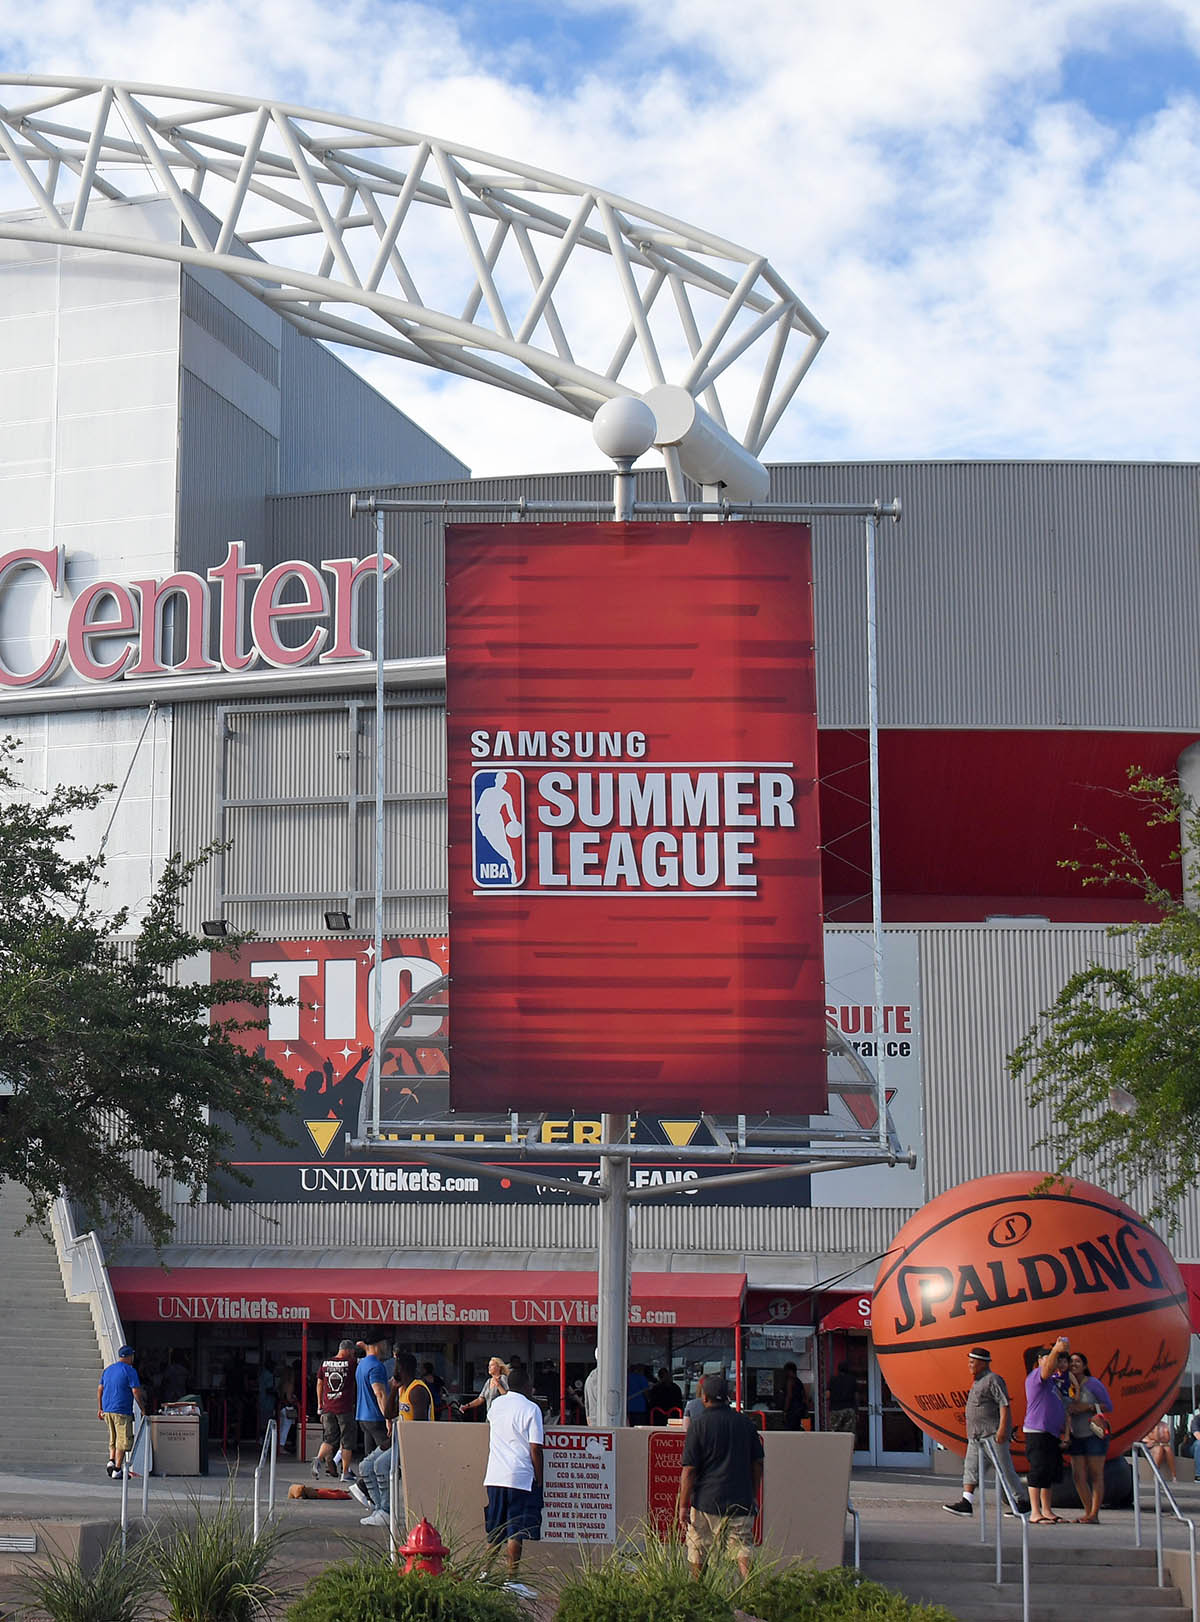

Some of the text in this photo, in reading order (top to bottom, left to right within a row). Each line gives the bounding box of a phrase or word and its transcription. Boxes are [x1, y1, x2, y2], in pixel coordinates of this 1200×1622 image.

[470, 730, 646, 758] SAMSUNG
[538, 771, 795, 827] SUMMER
[480, 863, 509, 879] NBA
[538, 831, 758, 888] LEAGUE
[299, 1167, 480, 1193] UNLVtickets.com
[895, 1224, 1163, 1335] SPALDING
[156, 1297, 310, 1320] UNLVtickets.com
[328, 1298, 489, 1321] UNLVtickets.com
[510, 1300, 677, 1324] UNLVtics.com
[548, 1461, 569, 1469] TICKET
[570, 1461, 599, 1470] SCALPING
[544, 1491, 568, 1499] LICENSE
[583, 1492, 610, 1500] STRICTLY
[546, 1481, 574, 1489] BUSINESS
[547, 1511, 561, 1519] MAY
[599, 1512, 607, 1520] TO
[580, 1502, 612, 1510] VIOLATORS
[548, 1521, 567, 1529] BEING
